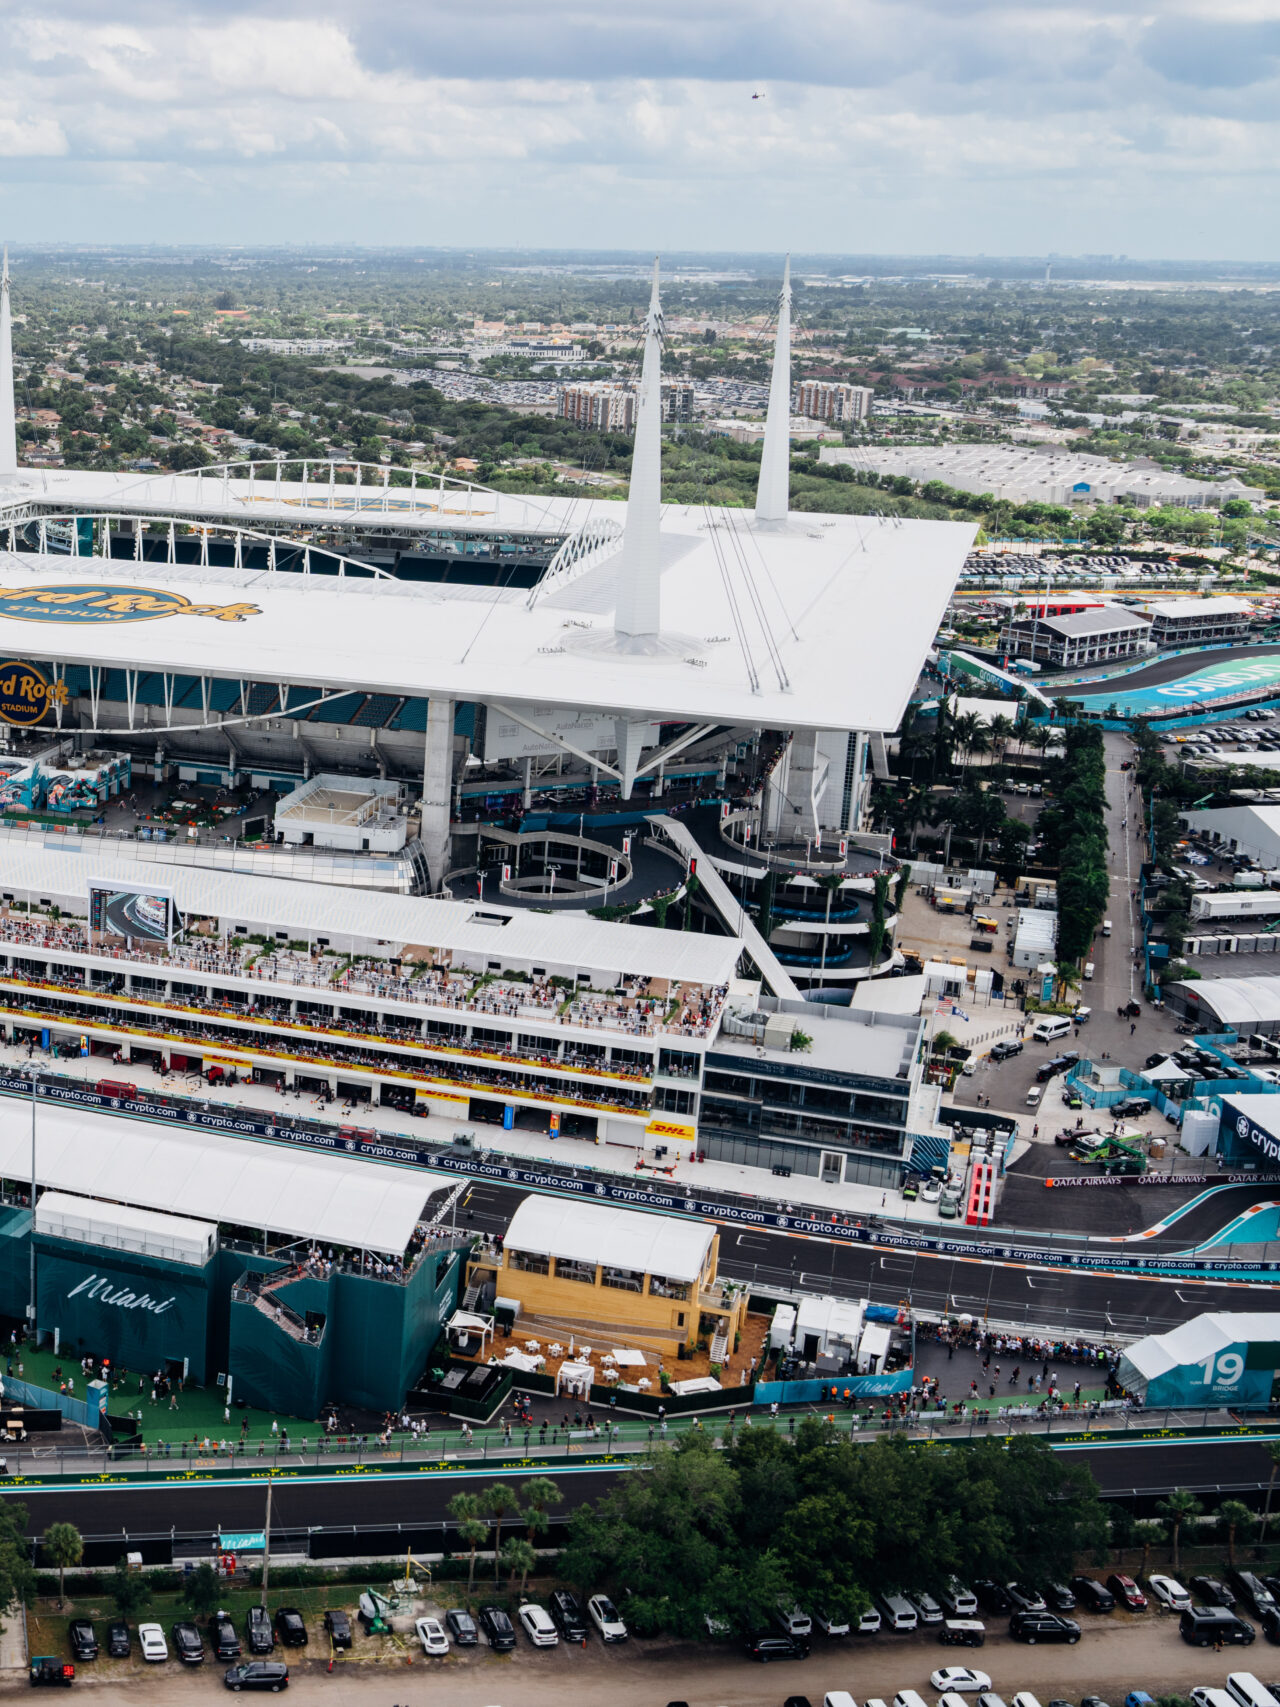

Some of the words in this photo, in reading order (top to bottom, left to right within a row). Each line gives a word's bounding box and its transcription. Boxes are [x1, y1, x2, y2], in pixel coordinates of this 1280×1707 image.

[5, 605, 125, 620] STADIUM
[83, 594, 264, 622] Rock
[979, 668, 1005, 690] aramco
[19, 674, 69, 706] Rock
[1, 703, 38, 714] STADIUM
[556, 722, 594, 730] AutoNation
[184, 1037, 201, 1045] DHL
[424, 1044, 444, 1052] DHL
[462, 1050, 483, 1058] DHL
[296, 1056, 314, 1064] DHL
[500, 1056, 521, 1064] DHL
[580, 1067, 603, 1076] DHL
[412, 1074, 432, 1082] DHL
[51, 1088, 102, 1104] crypto.com
[533, 1093, 554, 1102] DHL
[124, 1102, 177, 1118] crypto.com
[201, 1116, 255, 1132] crypto.com
[654, 1125, 685, 1135] DHL
[280, 1130, 335, 1146] crypto.com
[360, 1144, 417, 1161] crypto.com
[444, 1158, 502, 1176] crypto.com
[524, 1172, 584, 1190] crypto.com
[1053, 1178, 1082, 1186] QATAR
[1084, 1177, 1122, 1185] AIRWAYS
[1138, 1176, 1167, 1184] QATAR
[1228, 1175, 1258, 1183] QATAR
[612, 1188, 672, 1206] crypto.com
[701, 1204, 765, 1222] crypto.com
[794, 1220, 860, 1237] crypto.com
[880, 1236, 928, 1247] crypto.com
[1014, 1250, 1062, 1261] crypto.com
[1082, 1254, 1130, 1265] crypto.com
[1148, 1260, 1196, 1269] crypto.com
[1214, 1262, 1261, 1271] crypto.com
[67, 1274, 176, 1314] Miami
[1197, 1353, 1244, 1385] 19
[849, 1379, 898, 1395] Miami
